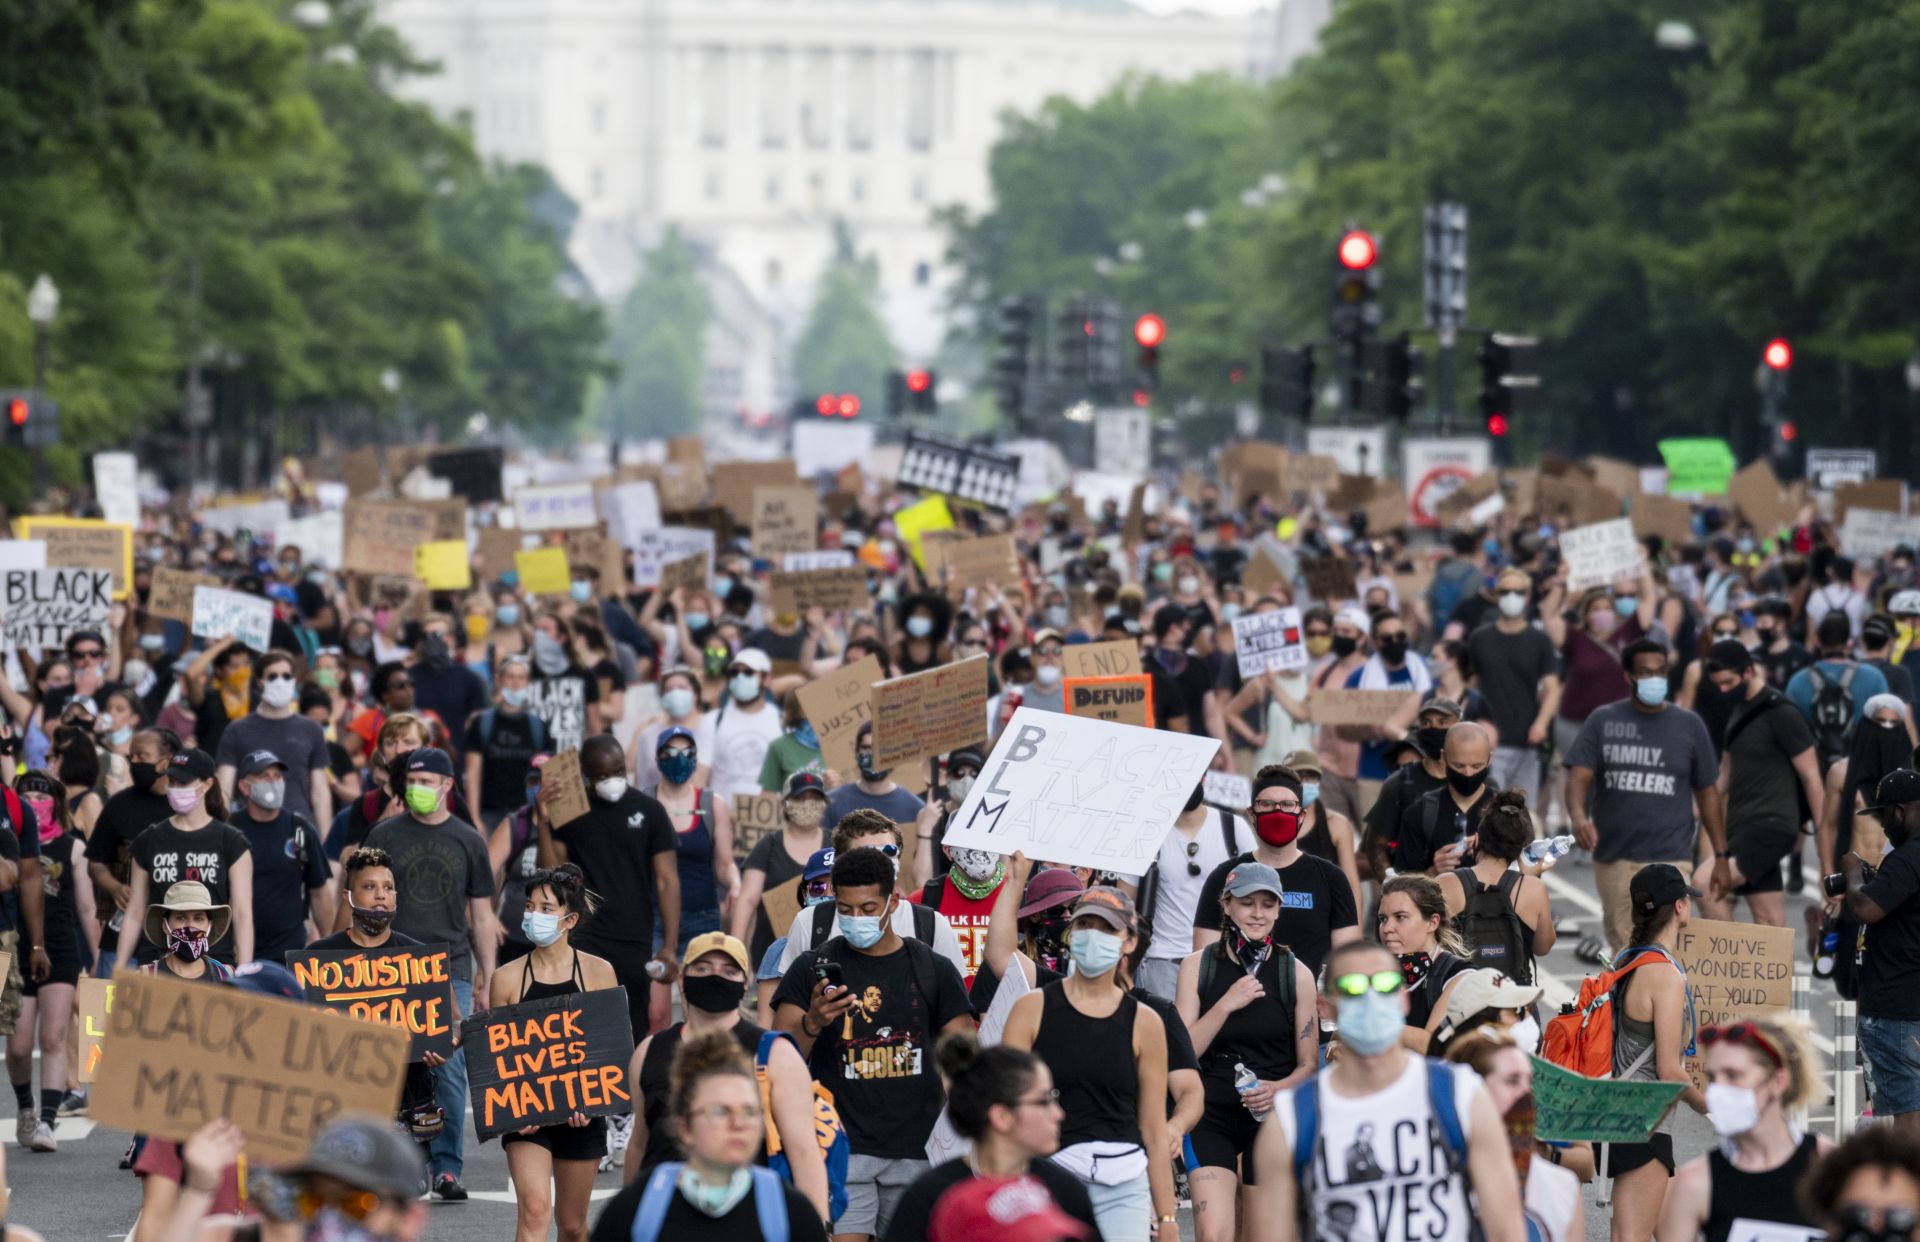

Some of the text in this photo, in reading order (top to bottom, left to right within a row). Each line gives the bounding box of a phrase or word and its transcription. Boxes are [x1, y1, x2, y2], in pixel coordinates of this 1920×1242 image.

[6, 569, 111, 608] BLACK
[3, 622, 96, 647] MATT
[1236, 611, 1287, 635] BLACK
[1238, 629, 1284, 655] LIVES
[1078, 648, 1130, 677] END
[835, 681, 861, 700] NO
[1074, 686, 1146, 708] DEFUND
[819, 699, 873, 738] JUSTI
[1098, 709, 1119, 720] THE
[1603, 721, 1642, 740] GOD.
[1004, 724, 1198, 792] BLACK
[1602, 744, 1665, 767] FAMILY.
[986, 760, 1181, 824] LIVES
[1604, 770, 1676, 796] STEELERS.
[965, 795, 1163, 860] MATTER
[1675, 932, 1767, 957] IF YOU'VE
[293, 951, 449, 991] NO JUSTICE
[1681, 958, 1789, 981] WONDERED
[1725, 986, 1768, 1008] YOU'D
[113, 979, 262, 1063] BLACK
[281, 1015, 400, 1090] LIVES
[487, 1008, 585, 1054] BLACK
[495, 1041, 587, 1080] LIVES
[132, 1061, 343, 1141] MATTER
[484, 1064, 631, 1127] MATTER
